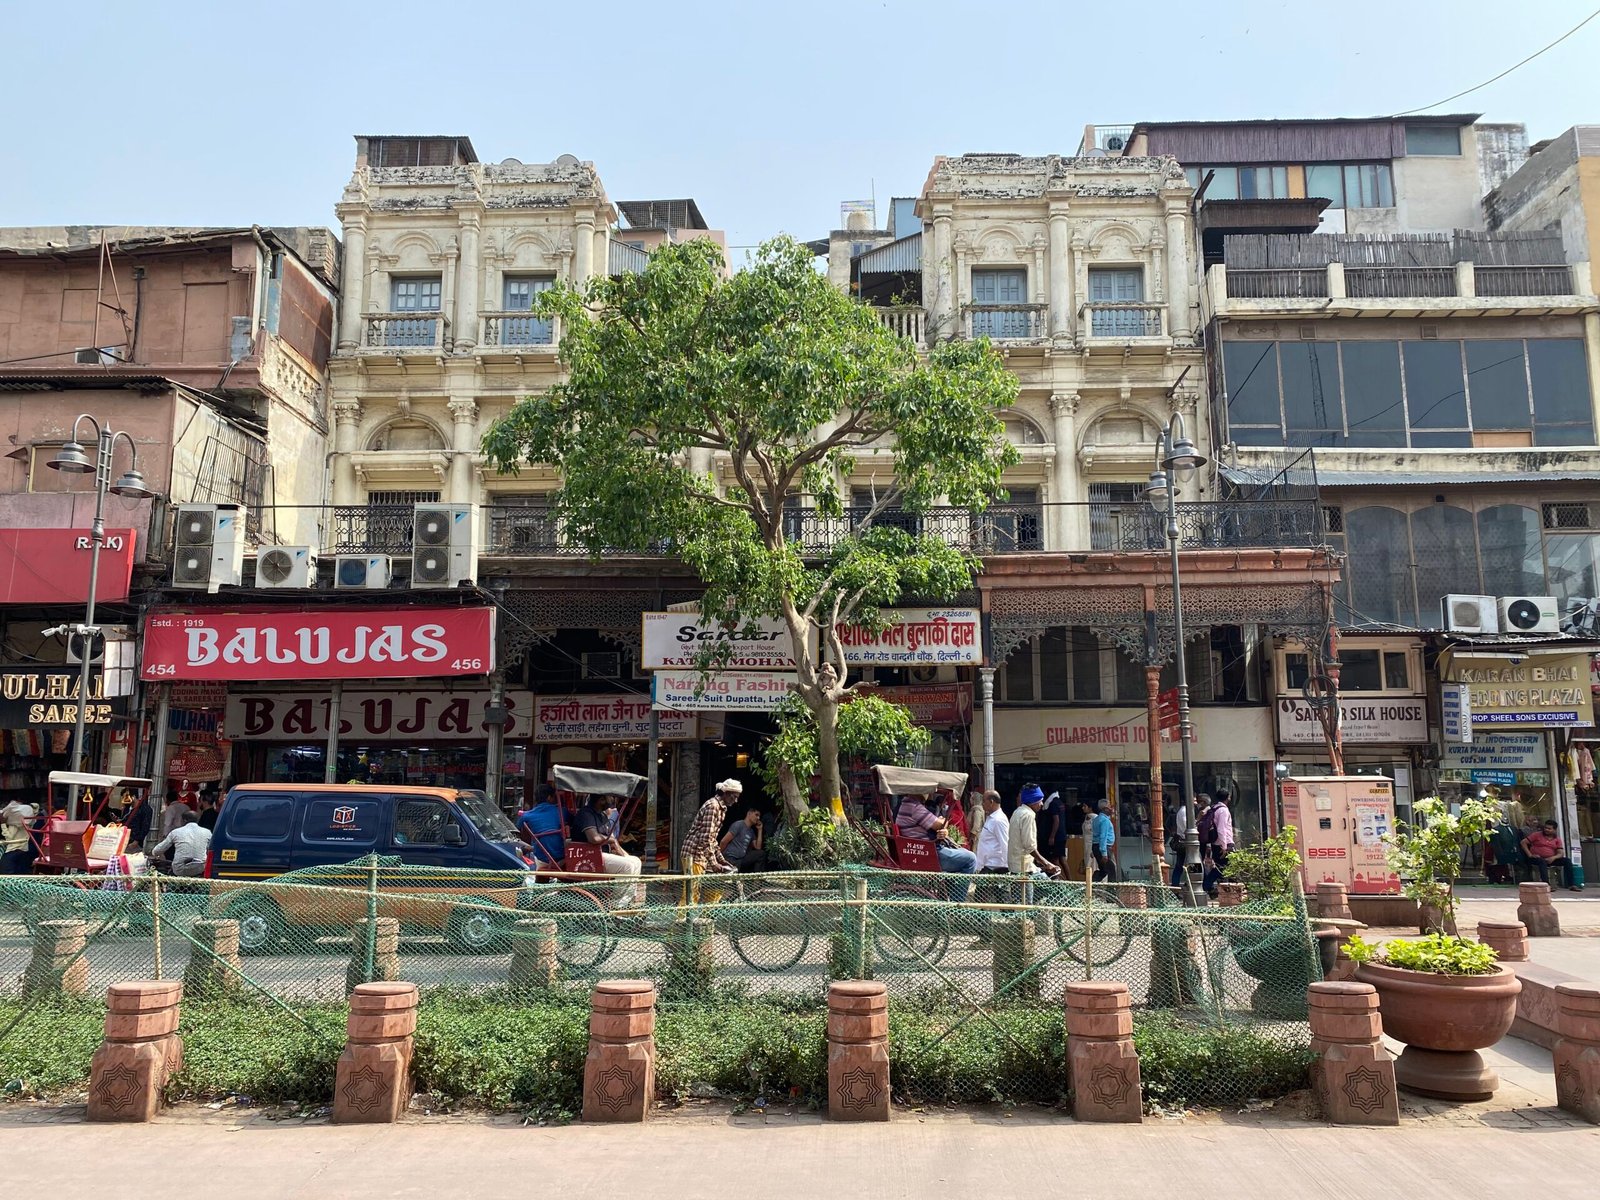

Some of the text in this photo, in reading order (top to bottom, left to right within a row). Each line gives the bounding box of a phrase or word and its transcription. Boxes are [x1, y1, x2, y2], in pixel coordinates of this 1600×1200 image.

[74, 536, 123, 551] (R..K)
[183, 619, 204, 627] 1919
[907, 617, 950, 650] बुलाकी
[951, 622, 975, 648] दास
[184, 624, 448, 666] BALUJAS
[451, 658, 481, 670] 456
[662, 657, 722, 666] KATA
[147, 664, 176, 675] 454
[1461, 666, 1578, 683] KARAN BHAI
[663, 678, 791, 693] Narng Fashi
[704, 695, 722, 703] Suit
[725, 695, 766, 704] Dupatta,
[898, 692, 956, 705] SHERWANI
[1470, 688, 1528, 707] EDDING
[1529, 687, 1586, 706] PLAZA
[28, 703, 112, 723] SAREE
[540, 701, 582, 723] हजारी
[583, 704, 610, 721] लाल
[611, 698, 634, 721] जैन
[1350, 707, 1376, 721] SILK
[1381, 706, 1421, 721] HOUSE
[1491, 713, 1514, 722] SHEEL
[1516, 713, 1536, 721] SONS
[1448, 746, 1533, 754] KURTA PYJAMA SHERWANI
[1308, 848, 1346, 856] BSES
